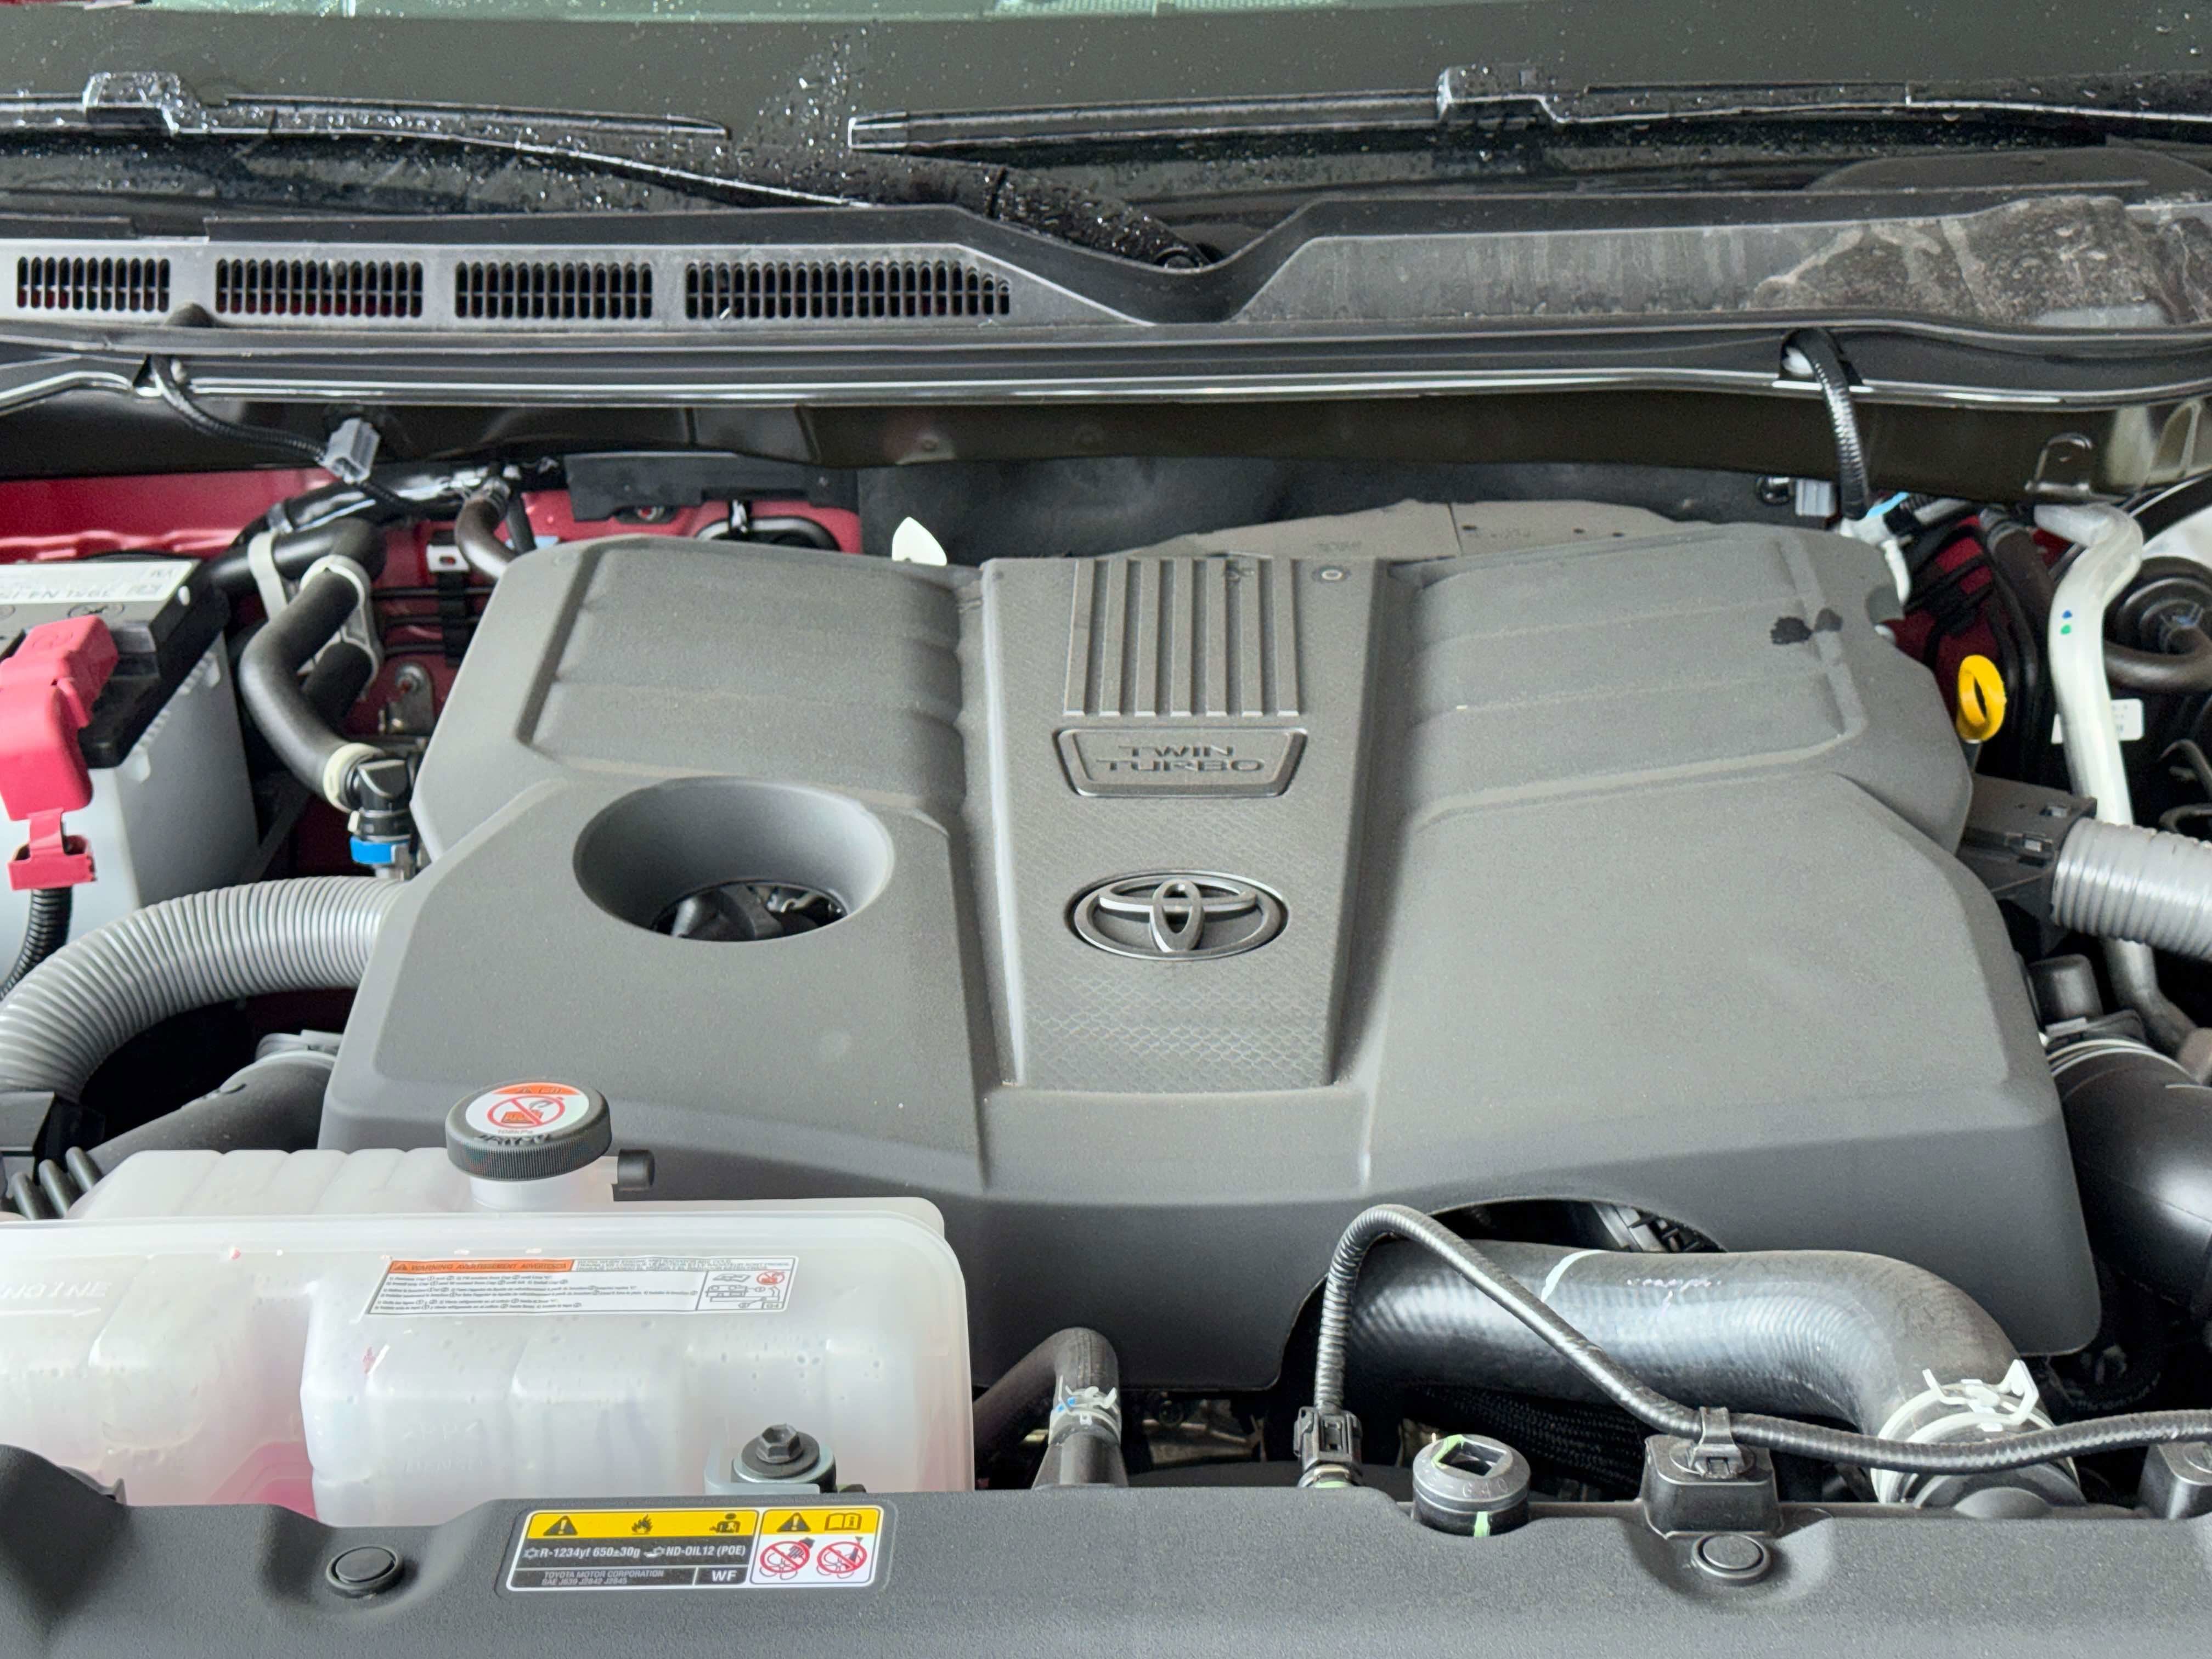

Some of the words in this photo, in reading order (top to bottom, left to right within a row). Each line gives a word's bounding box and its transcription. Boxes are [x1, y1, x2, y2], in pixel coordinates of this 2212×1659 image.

[1118, 744, 1234, 757] TWIN
[1096, 758, 1266, 772] TURBO
[540, 1547, 591, 1559] R-1234yf
[592, 1547, 641, 1559] 650±30g
[665, 1545, 715, 1556] ND-OIL12
[716, 1545, 746, 1558] (POE)
[544, 1571, 574, 1579] TOYOTA
[576, 1570, 606, 1578] MOTOR
[607, 1570, 664, 1578] CORPORATION
[712, 1570, 737, 1582] WF
